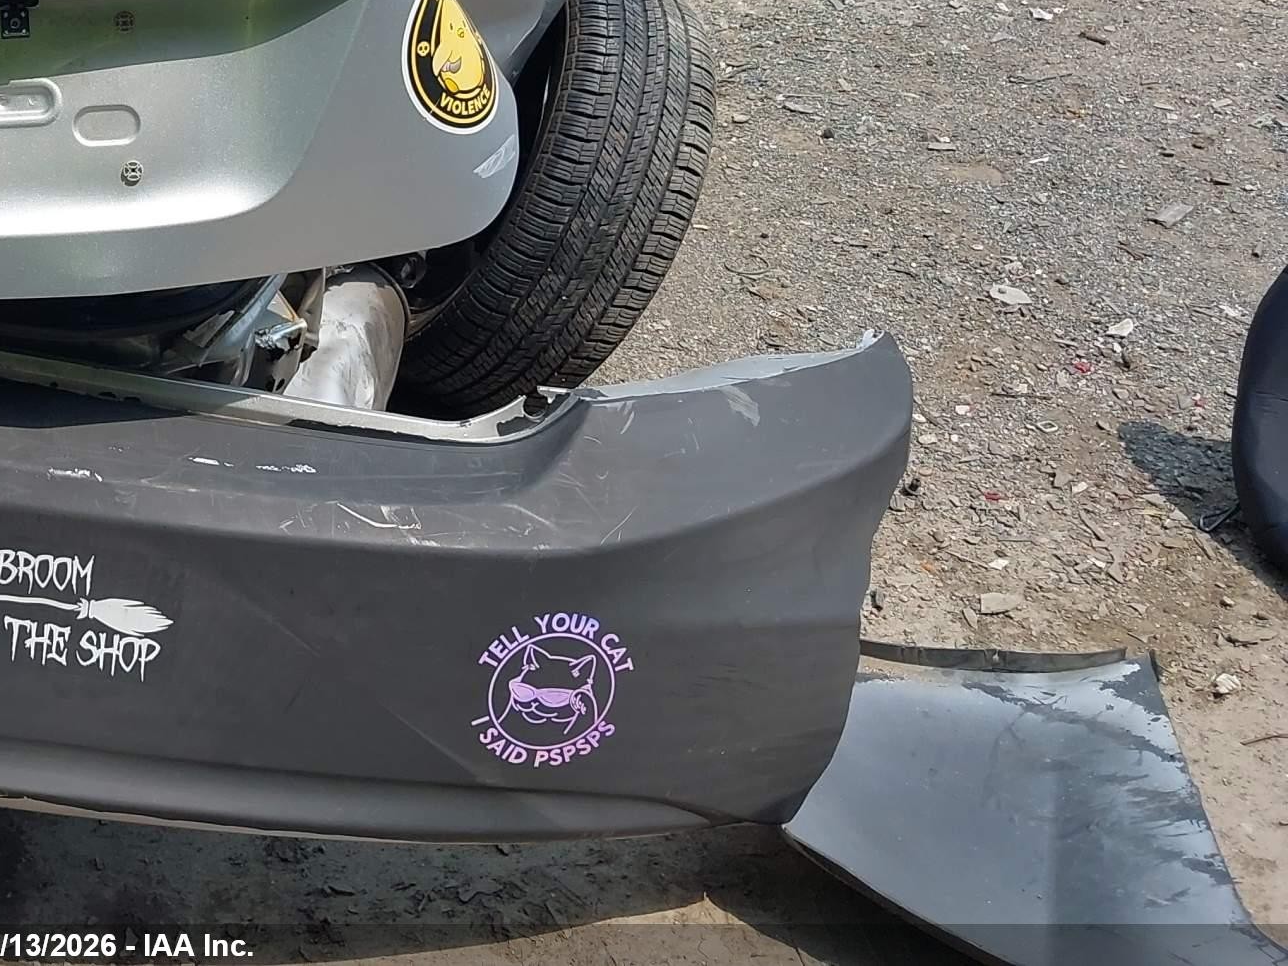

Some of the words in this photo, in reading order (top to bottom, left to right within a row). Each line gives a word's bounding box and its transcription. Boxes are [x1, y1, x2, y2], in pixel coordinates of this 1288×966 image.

[439, 83, 491, 116] VIOLENCE
[3, 614, 72, 667] THE
[75, 630, 162, 683] SHOP
[477, 626, 531, 668] TELL
[534, 612, 601, 640] YOUR
[600, 632, 635, 673] CAT
[470, 716, 490, 726] I
[479, 727, 528, 764] SAID
[533, 720, 616, 768] PSPSPS
